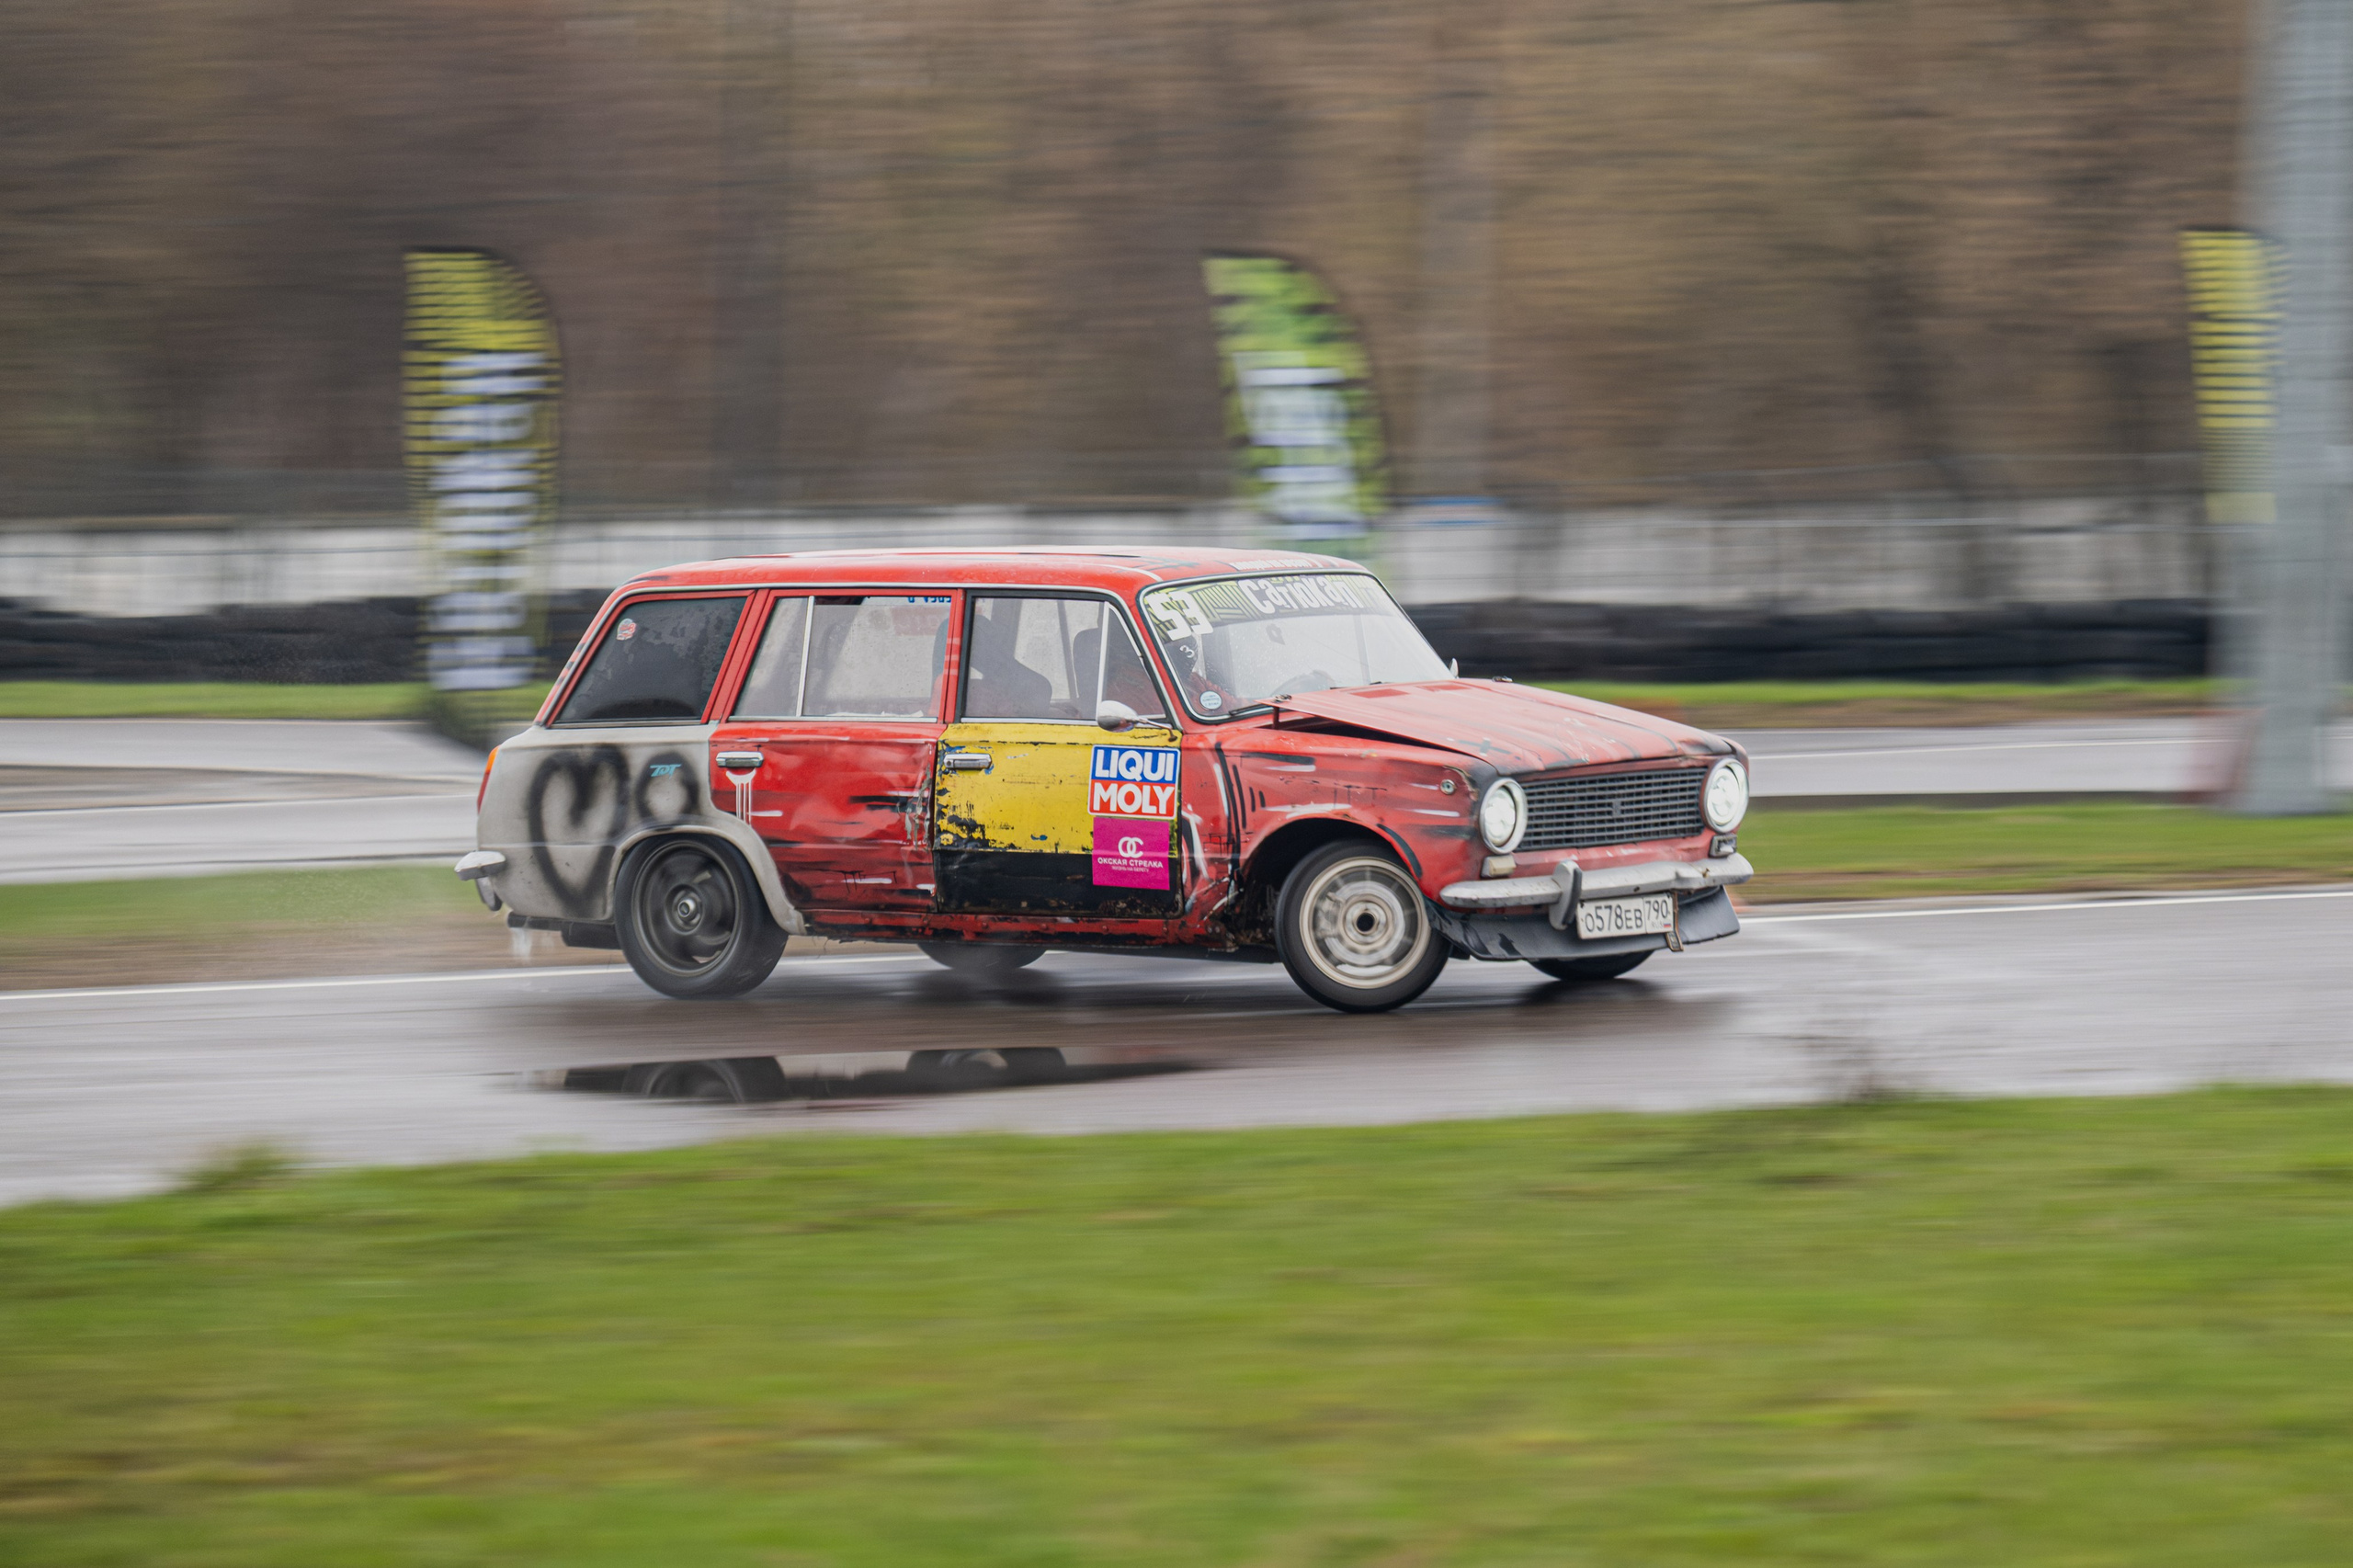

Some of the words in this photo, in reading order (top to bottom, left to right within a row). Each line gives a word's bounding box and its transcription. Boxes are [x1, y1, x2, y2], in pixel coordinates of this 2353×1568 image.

[1144, 591, 1213, 641] 53
[1095, 749, 1176, 781] LIQUI
[1093, 782, 1175, 814] MOLY
[1097, 857, 1127, 865] ОКСКАЯ
[1129, 859, 1163, 868] СТРЕЛКА
[1645, 900, 1668, 920] 790
